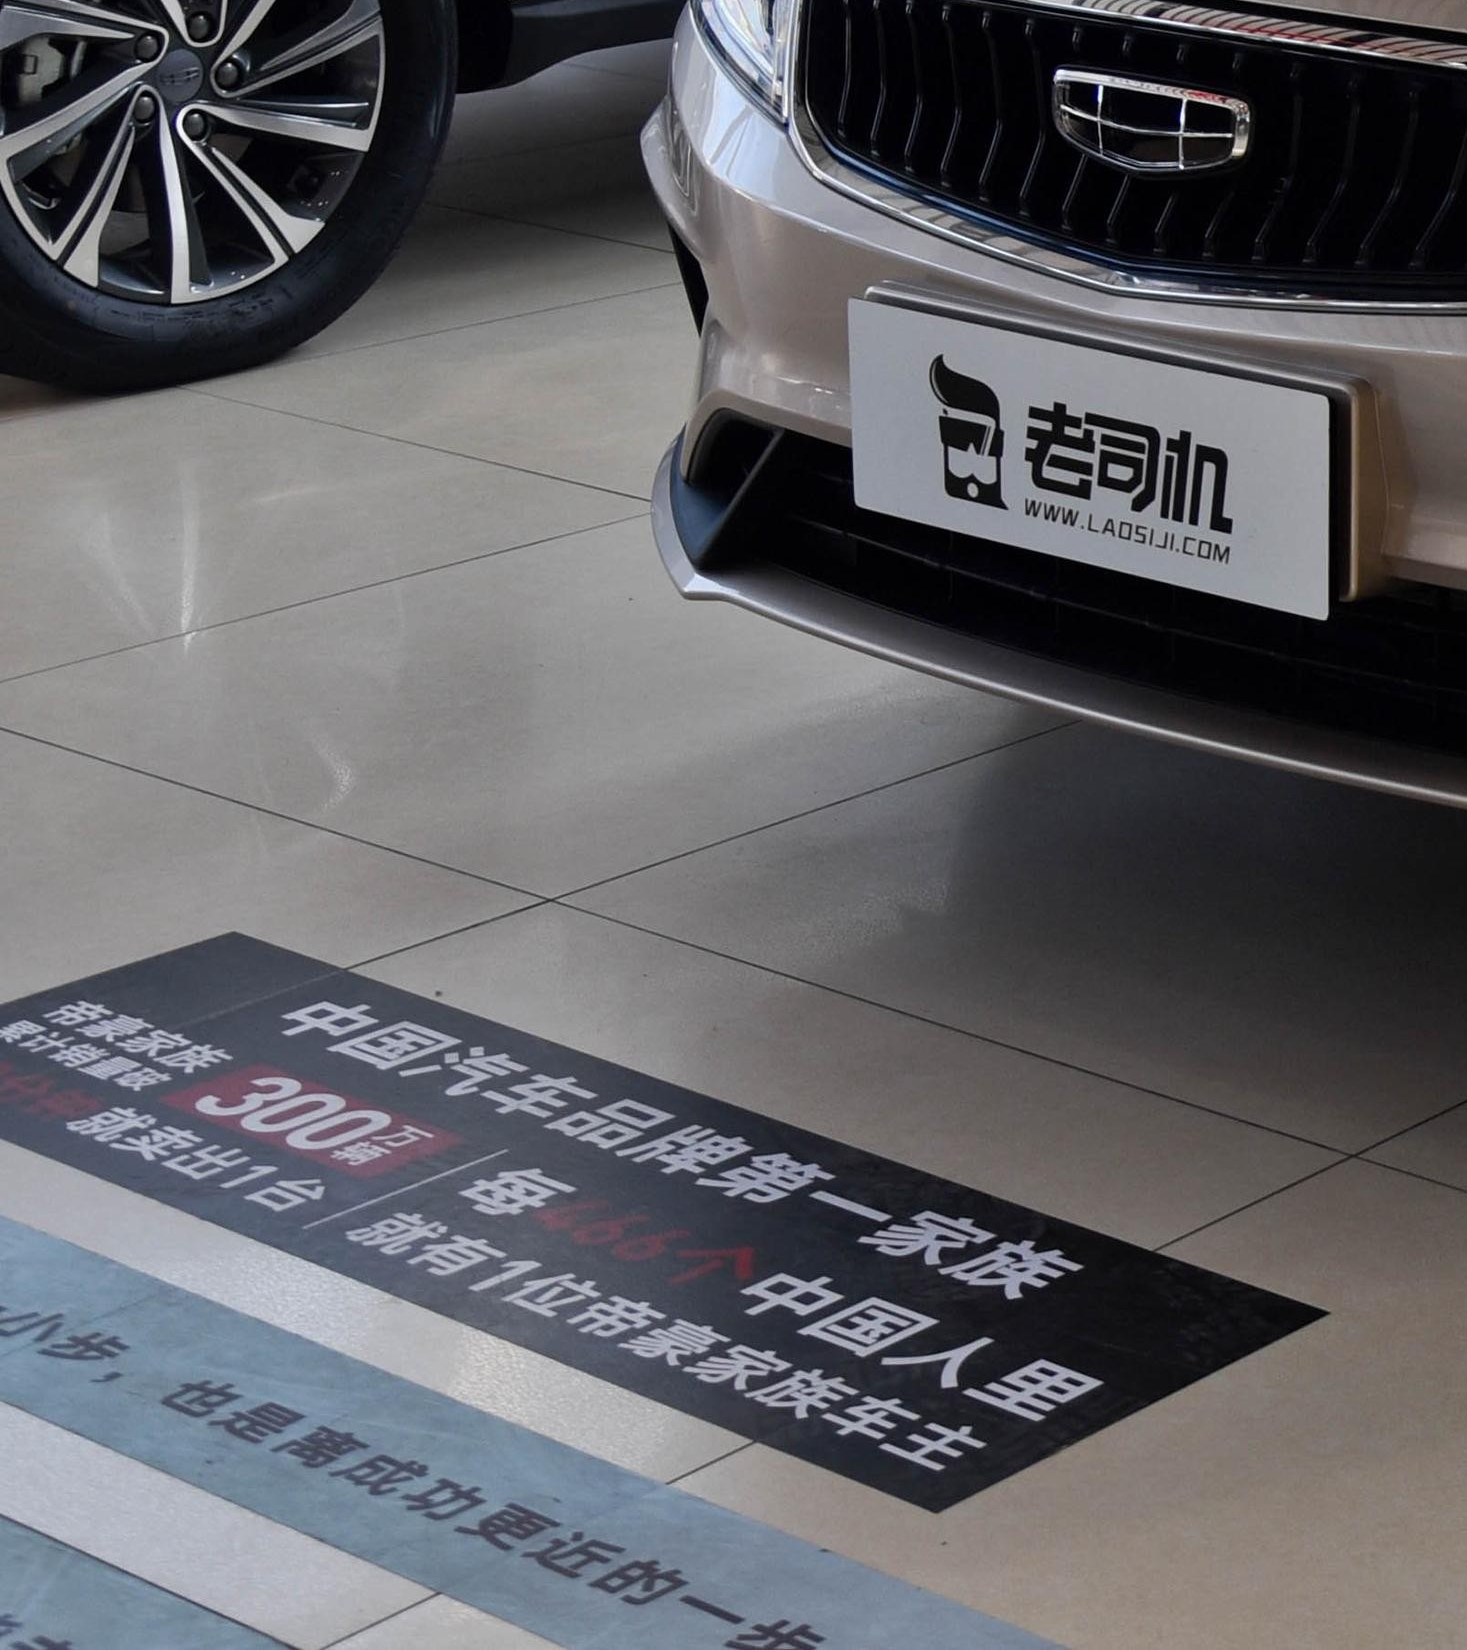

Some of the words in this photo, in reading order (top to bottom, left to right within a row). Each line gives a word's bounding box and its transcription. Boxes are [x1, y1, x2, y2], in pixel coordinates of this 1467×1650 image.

[1024, 498, 1231, 565] WWW.LAOSIJI.COM
[1025, 401, 1234, 535] 老司机
[43, 1000, 234, 1073] 帝豪家族
[195, 1076, 392, 1150] 300
[281, 1000, 1085, 1300] 中国汽车品牌第一家族
[345, 1212, 987, 1471] 就有1位帝豪家族车主
[0, 1305, 827, 1650] 小步，也是离成功更近的一步
